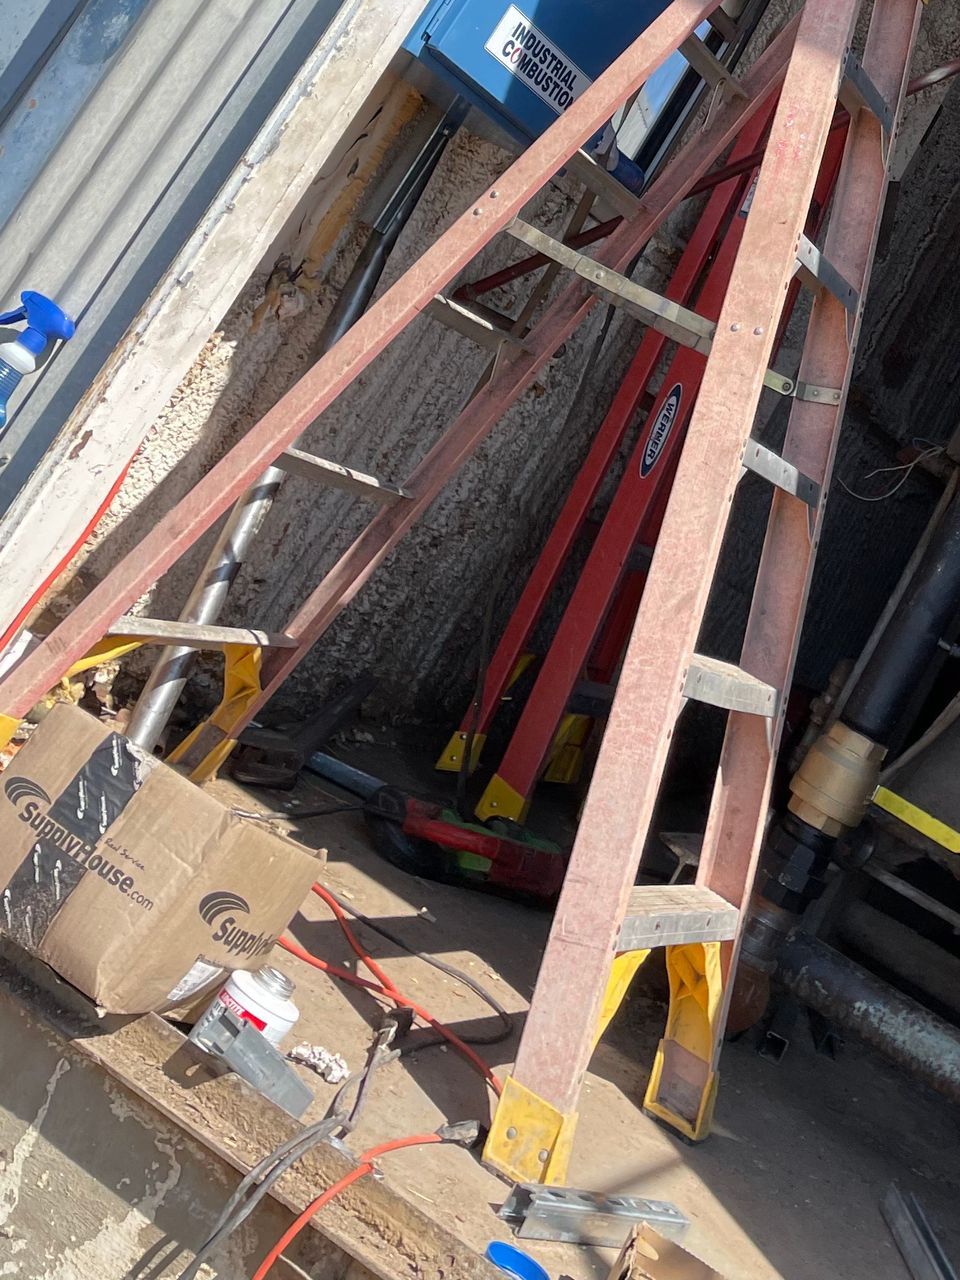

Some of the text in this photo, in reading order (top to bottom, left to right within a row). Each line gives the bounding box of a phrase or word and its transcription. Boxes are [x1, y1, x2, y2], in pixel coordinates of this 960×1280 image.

[511, 21, 577, 92] INDUSTRIAL
[647, 403, 675, 460] WERNER
[17, 801, 155, 911] SupplyHouse.com
